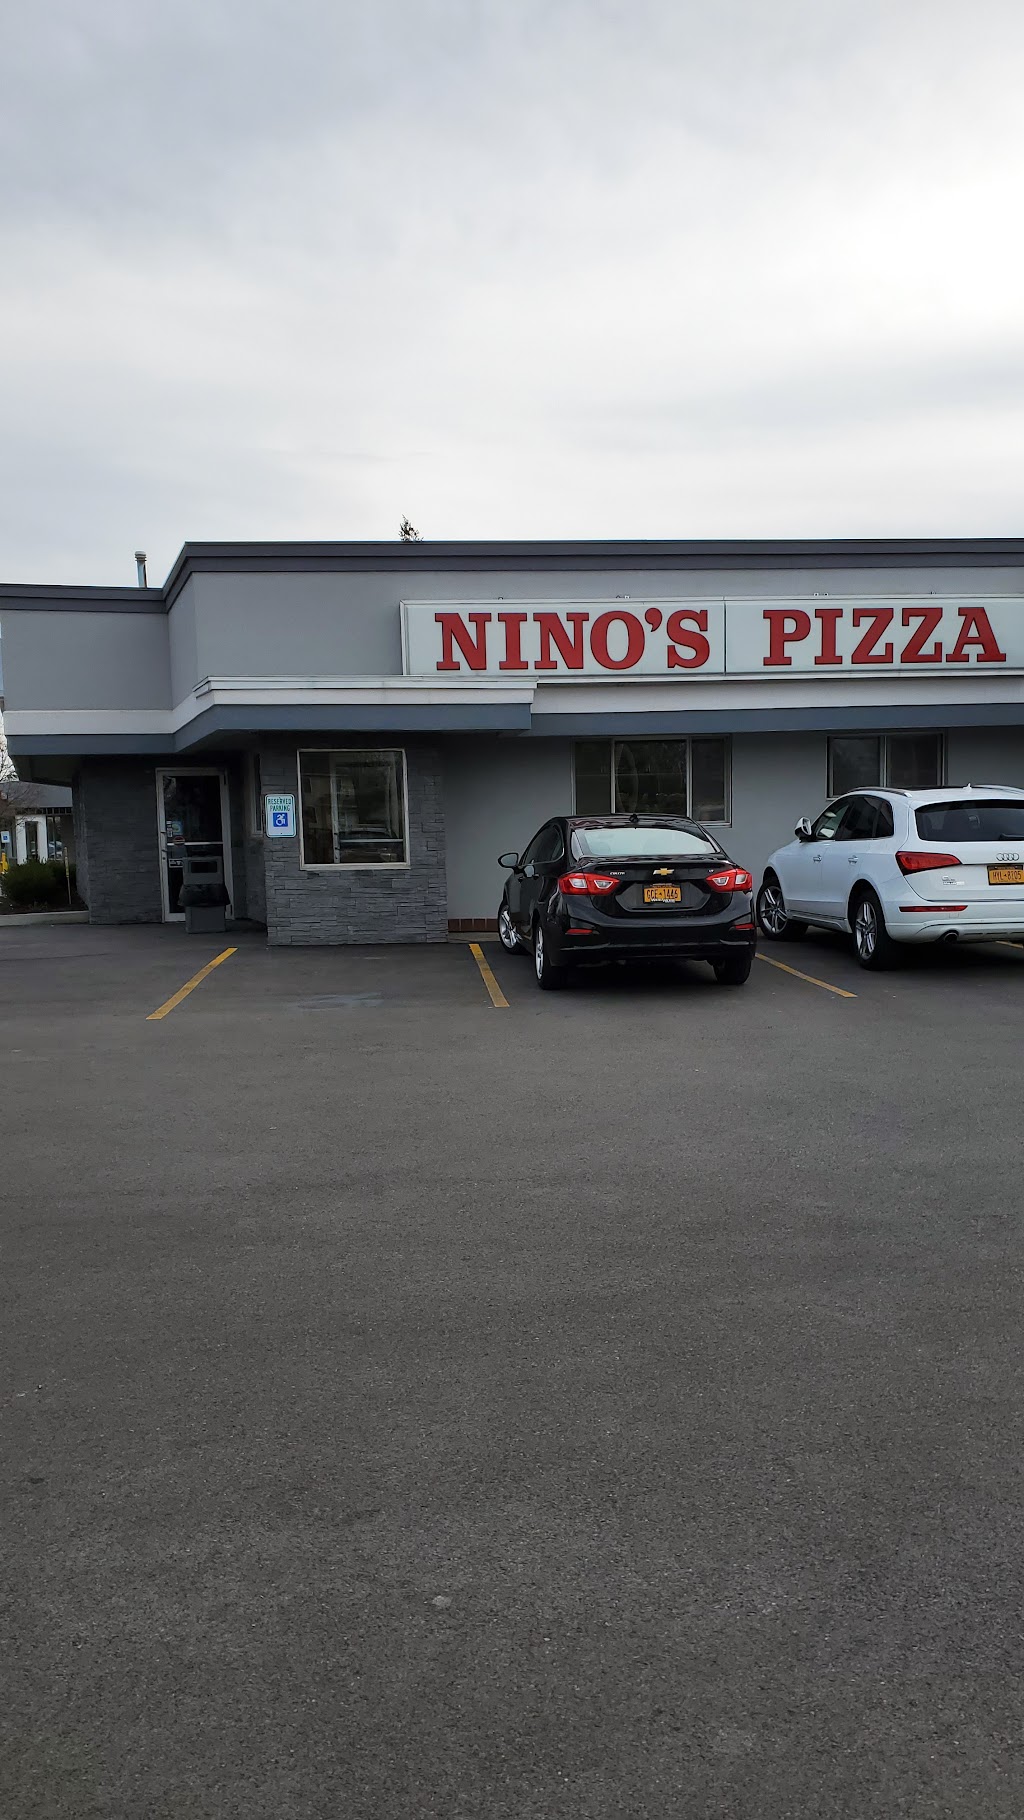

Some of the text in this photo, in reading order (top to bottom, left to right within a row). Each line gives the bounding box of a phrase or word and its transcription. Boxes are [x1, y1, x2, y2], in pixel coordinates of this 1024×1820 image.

[434, 606, 1007, 671] NINO'S PIZZA
[267, 797, 291, 805] RESERVED
[270, 804, 290, 812] PARKING
